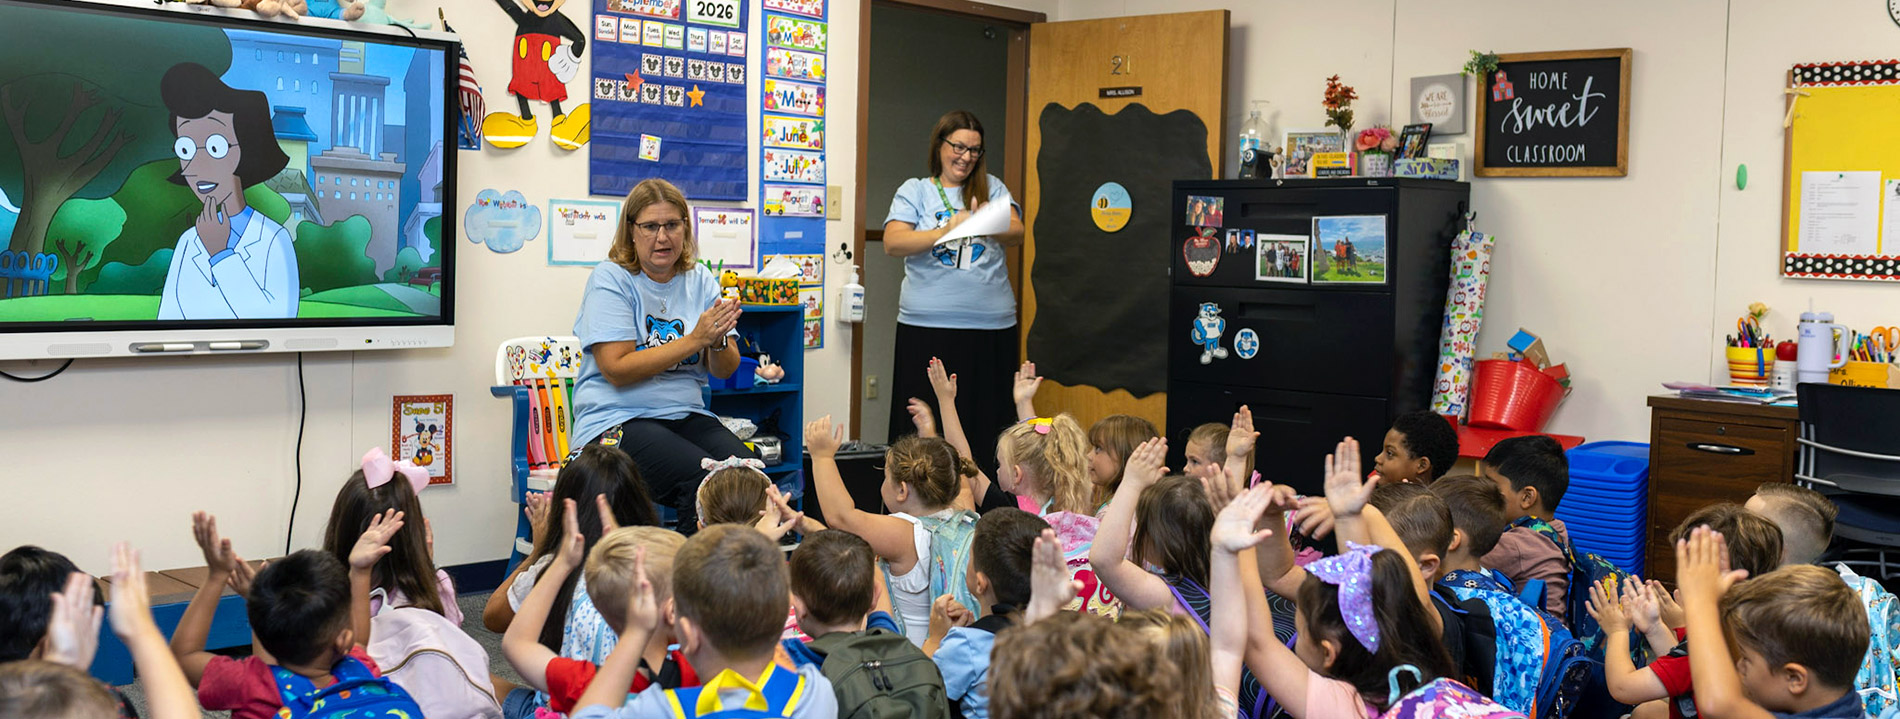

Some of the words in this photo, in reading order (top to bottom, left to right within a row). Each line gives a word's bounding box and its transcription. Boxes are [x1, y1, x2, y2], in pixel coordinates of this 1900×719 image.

[697, 2, 733, 19] 2026
[1111, 55, 1130, 75] 21
[1530, 72, 1568, 90] HOME
[781, 90, 811, 112] May
[1501, 76, 1606, 134] sweet
[780, 126, 807, 143] June
[1507, 144, 1586, 163] CLASSROOM
[782, 158, 805, 178] July
